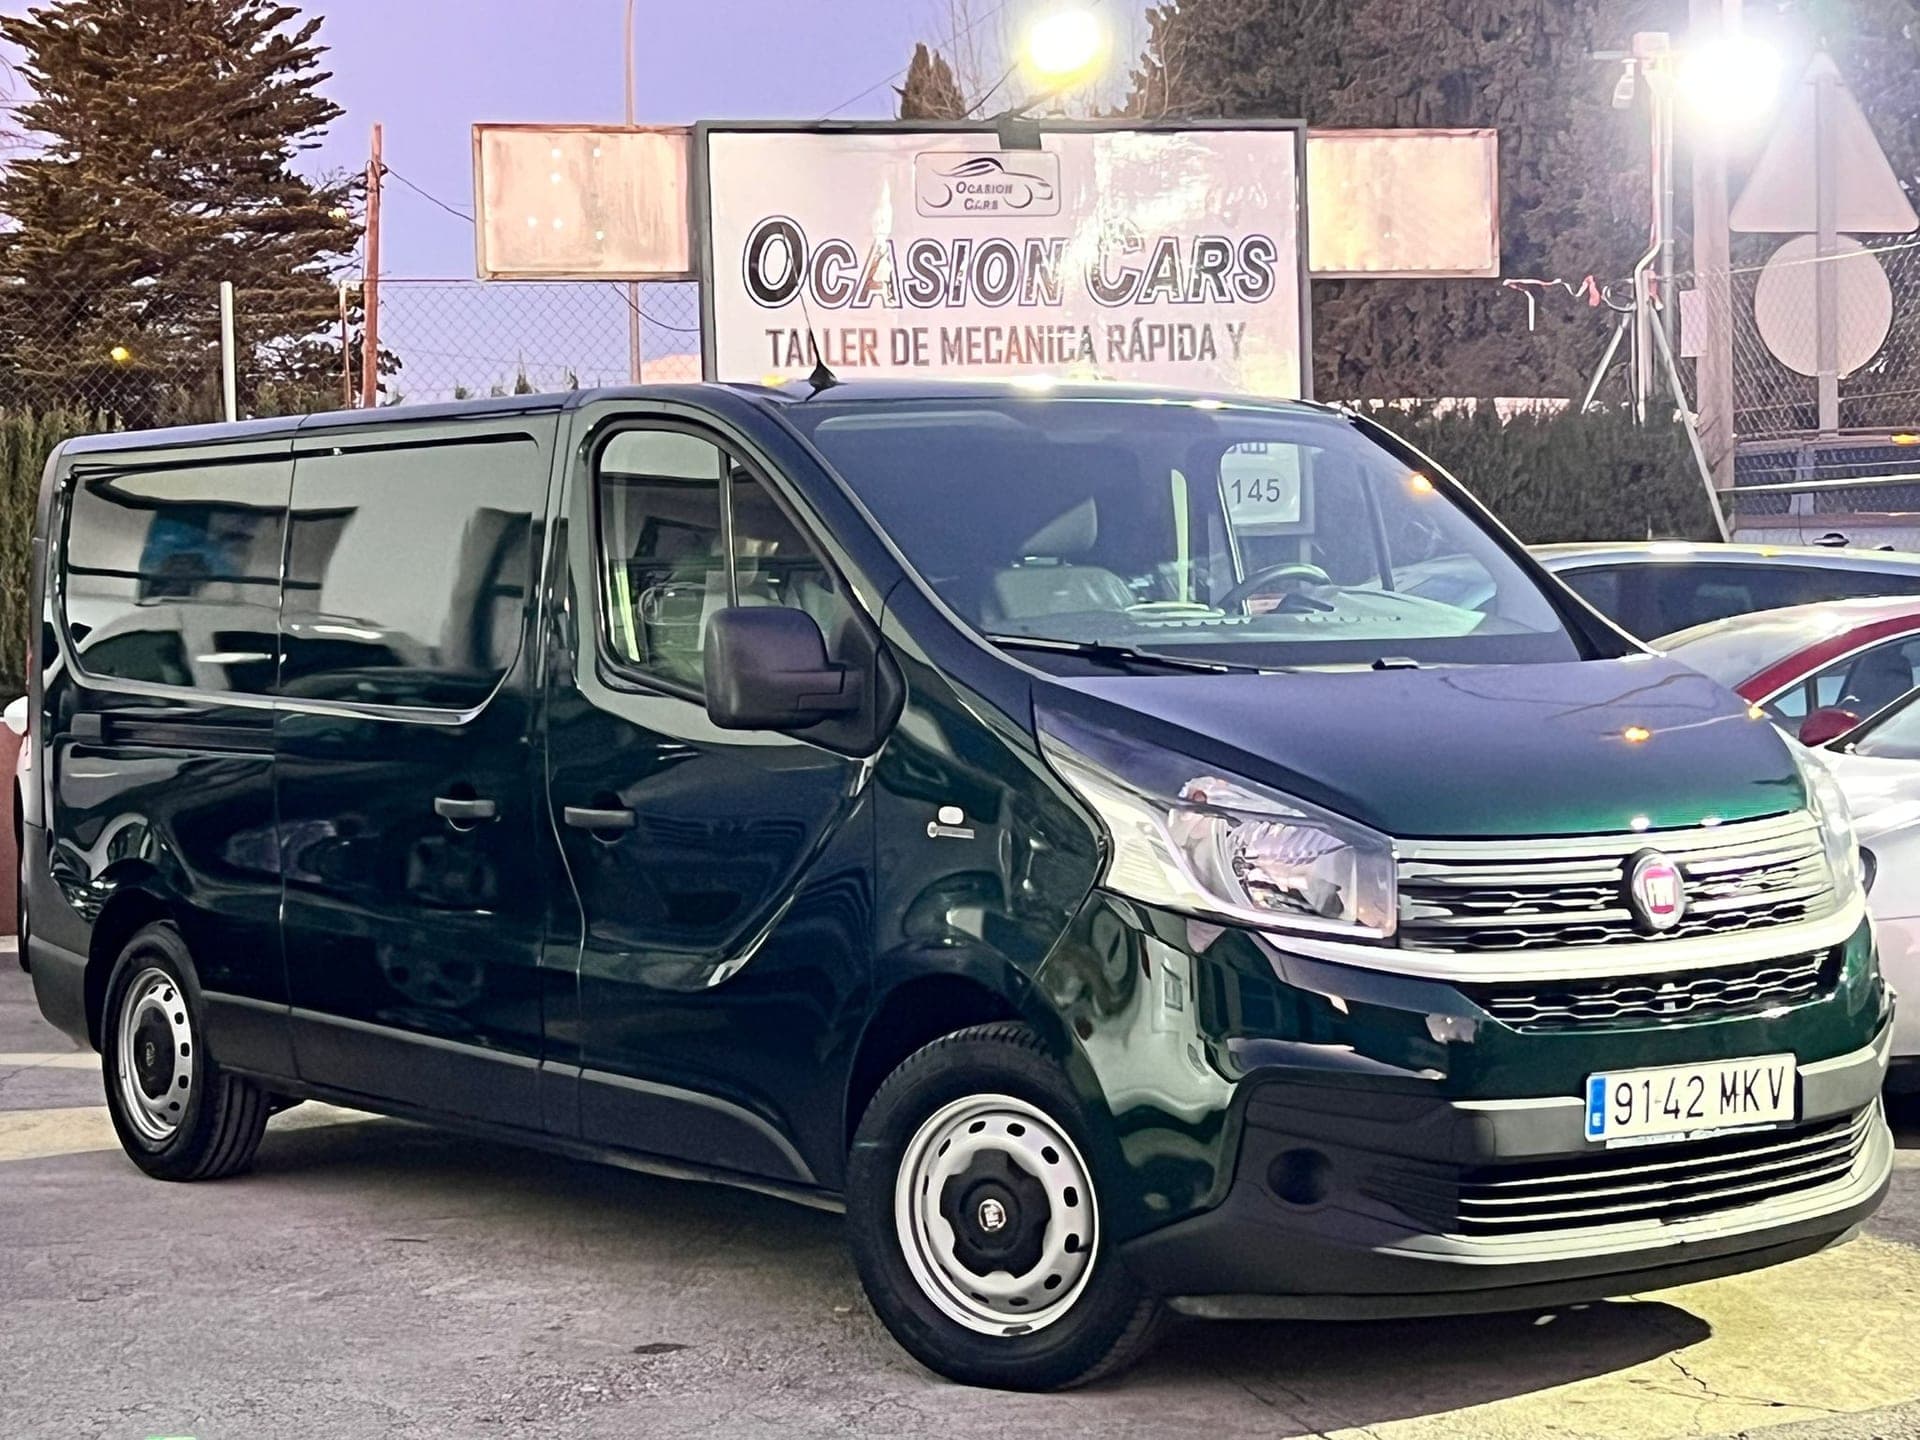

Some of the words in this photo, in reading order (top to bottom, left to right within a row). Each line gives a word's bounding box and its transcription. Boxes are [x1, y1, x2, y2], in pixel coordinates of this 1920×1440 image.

[956, 181, 1013, 195] OCASION
[743, 215, 1067, 308] OCASION
[1083, 218, 1277, 306] CARS
[765, 326, 879, 367] TALLER
[892, 327, 929, 367] DE
[940, 324, 1096, 366] MECANICA
[1106, 317, 1217, 362] RÁPIDA
[1227, 322, 1247, 359] Y
[1231, 478, 1281, 504] 145
[1614, 1074, 1705, 1126] 9142
[1719, 1065, 1785, 1115] MKV
